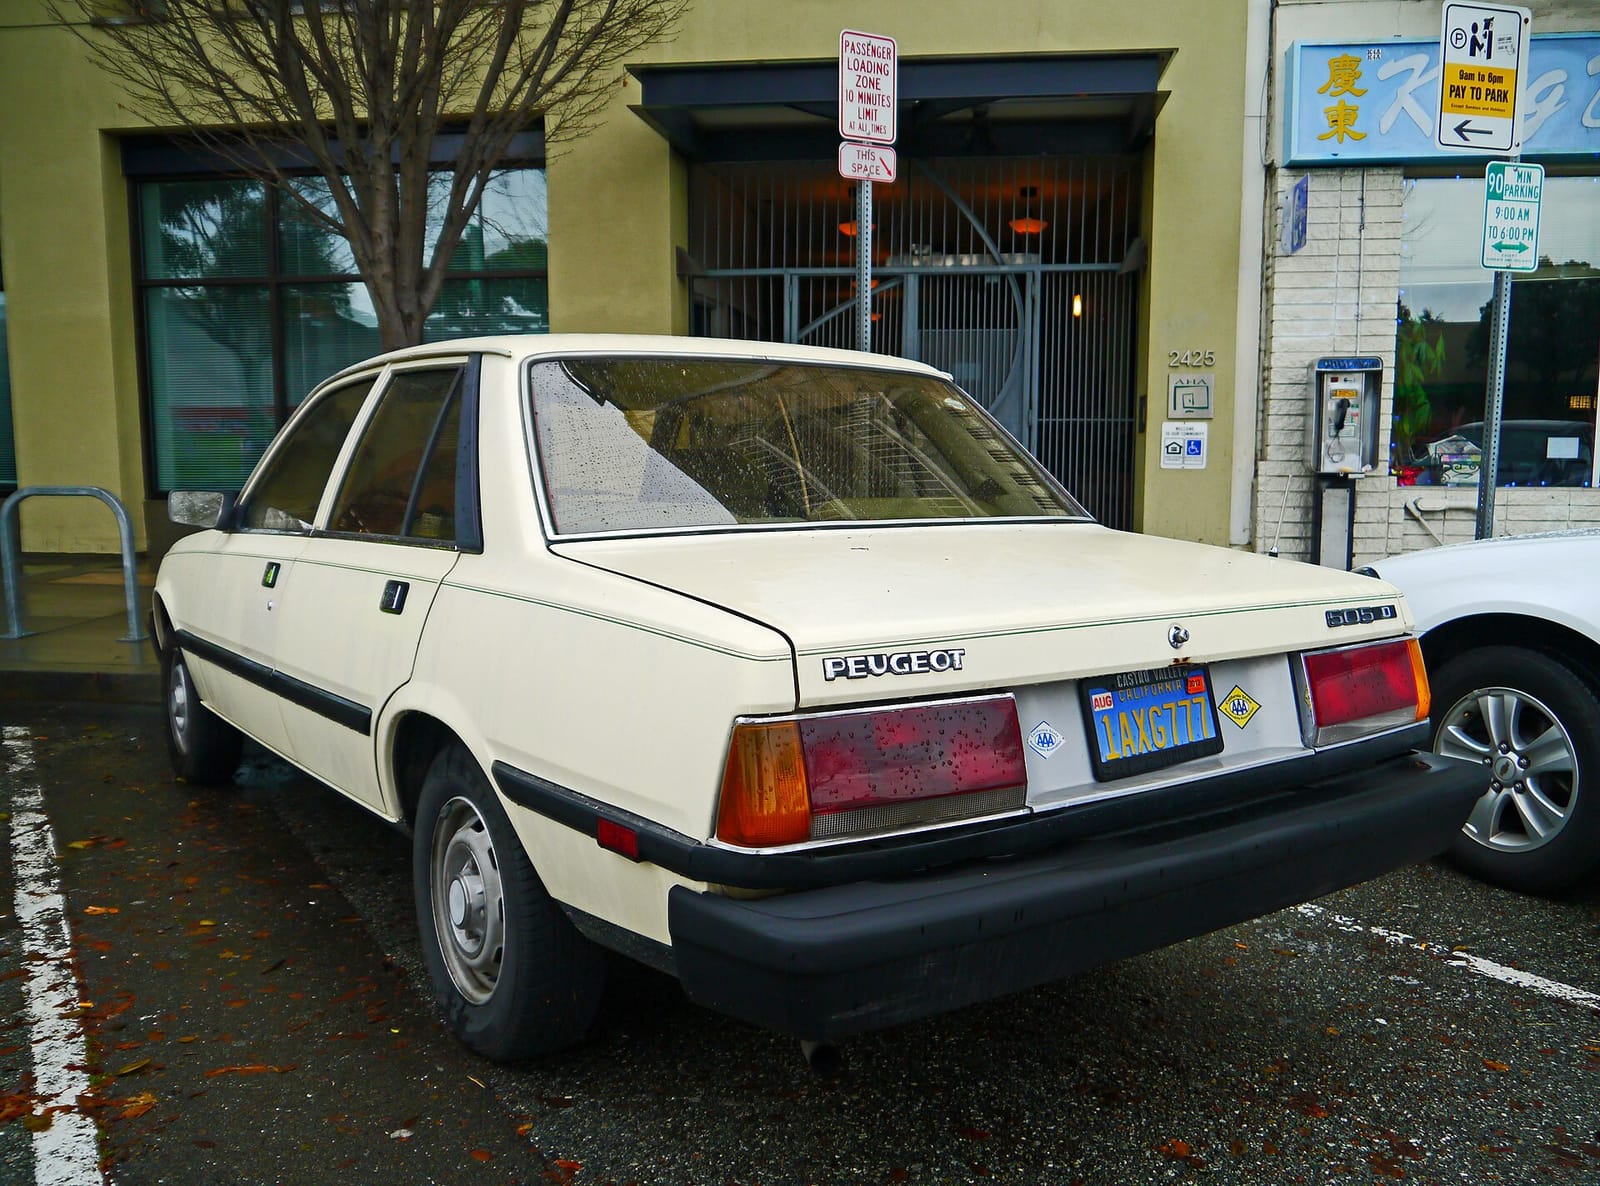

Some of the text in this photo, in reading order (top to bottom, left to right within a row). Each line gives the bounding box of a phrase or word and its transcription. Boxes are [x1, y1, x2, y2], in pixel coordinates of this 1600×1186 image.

[844, 39, 892, 60] PASSENGER
[847, 57, 890, 77] LOADING
[855, 74, 881, 91] ZONE
[1458, 69, 1504, 85] 9am to 6pm
[845, 88, 891, 108] 10 MINUTES
[1316, 52, 1369, 144] 慶東
[1449, 84, 1509, 103] PAY TO PARK
[857, 106, 878, 121] LIMIT
[848, 120, 887, 135] AT ALL TIMES
[856, 149, 876, 161] THIS
[851, 162, 881, 176] SPACE
[1488, 170, 1532, 194] 90 MIN
[1504, 183, 1539, 199] PARKING
[1495, 206, 1530, 221] 9:00 AM
[1488, 225, 1534, 241] TO 6:00 PM
[1168, 349, 1216, 368] 2425
[1326, 607, 1374, 627] 505
[822, 648, 965, 682] PEUGEOT
[1116, 666, 1182, 688] CASTRO VALLEY
[1118, 679, 1183, 702] CALIFORNIA
[1093, 695, 1113, 709] AUG
[1231, 698, 1249, 715] AAA
[1101, 696, 1209, 761] 1AXG777
[1036, 732, 1055, 748] AAA
